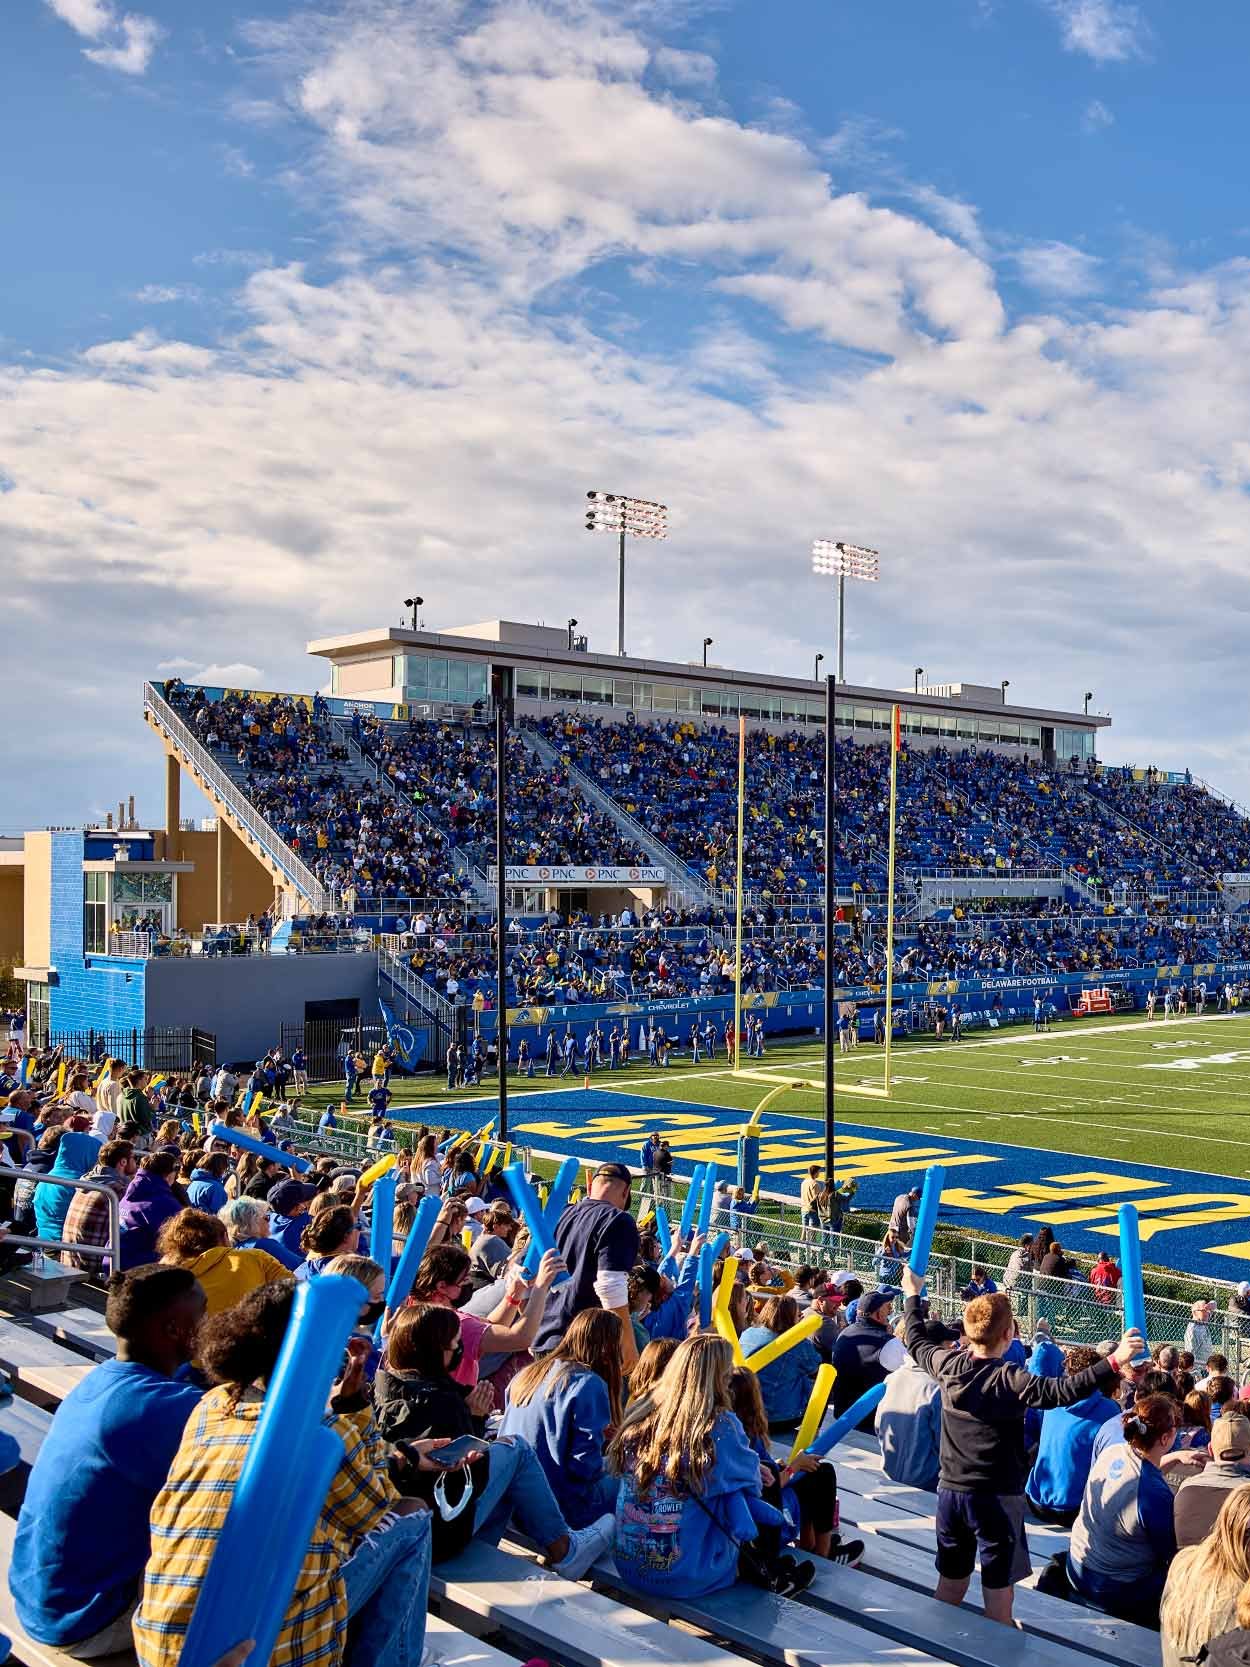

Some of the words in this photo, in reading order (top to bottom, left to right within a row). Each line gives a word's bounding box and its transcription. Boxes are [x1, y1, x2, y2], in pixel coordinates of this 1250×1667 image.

[505, 868, 529, 879] PNC
[552, 868, 576, 879] PNC
[599, 868, 620, 879] PNC
[641, 868, 663, 879] PNC
[981, 976, 1021, 989] DELAWARE
[1022, 976, 1058, 987] FOOTBALL
[647, 1002, 689, 1012] CHEVROLET
[511, 1113, 1005, 1181] HENS
